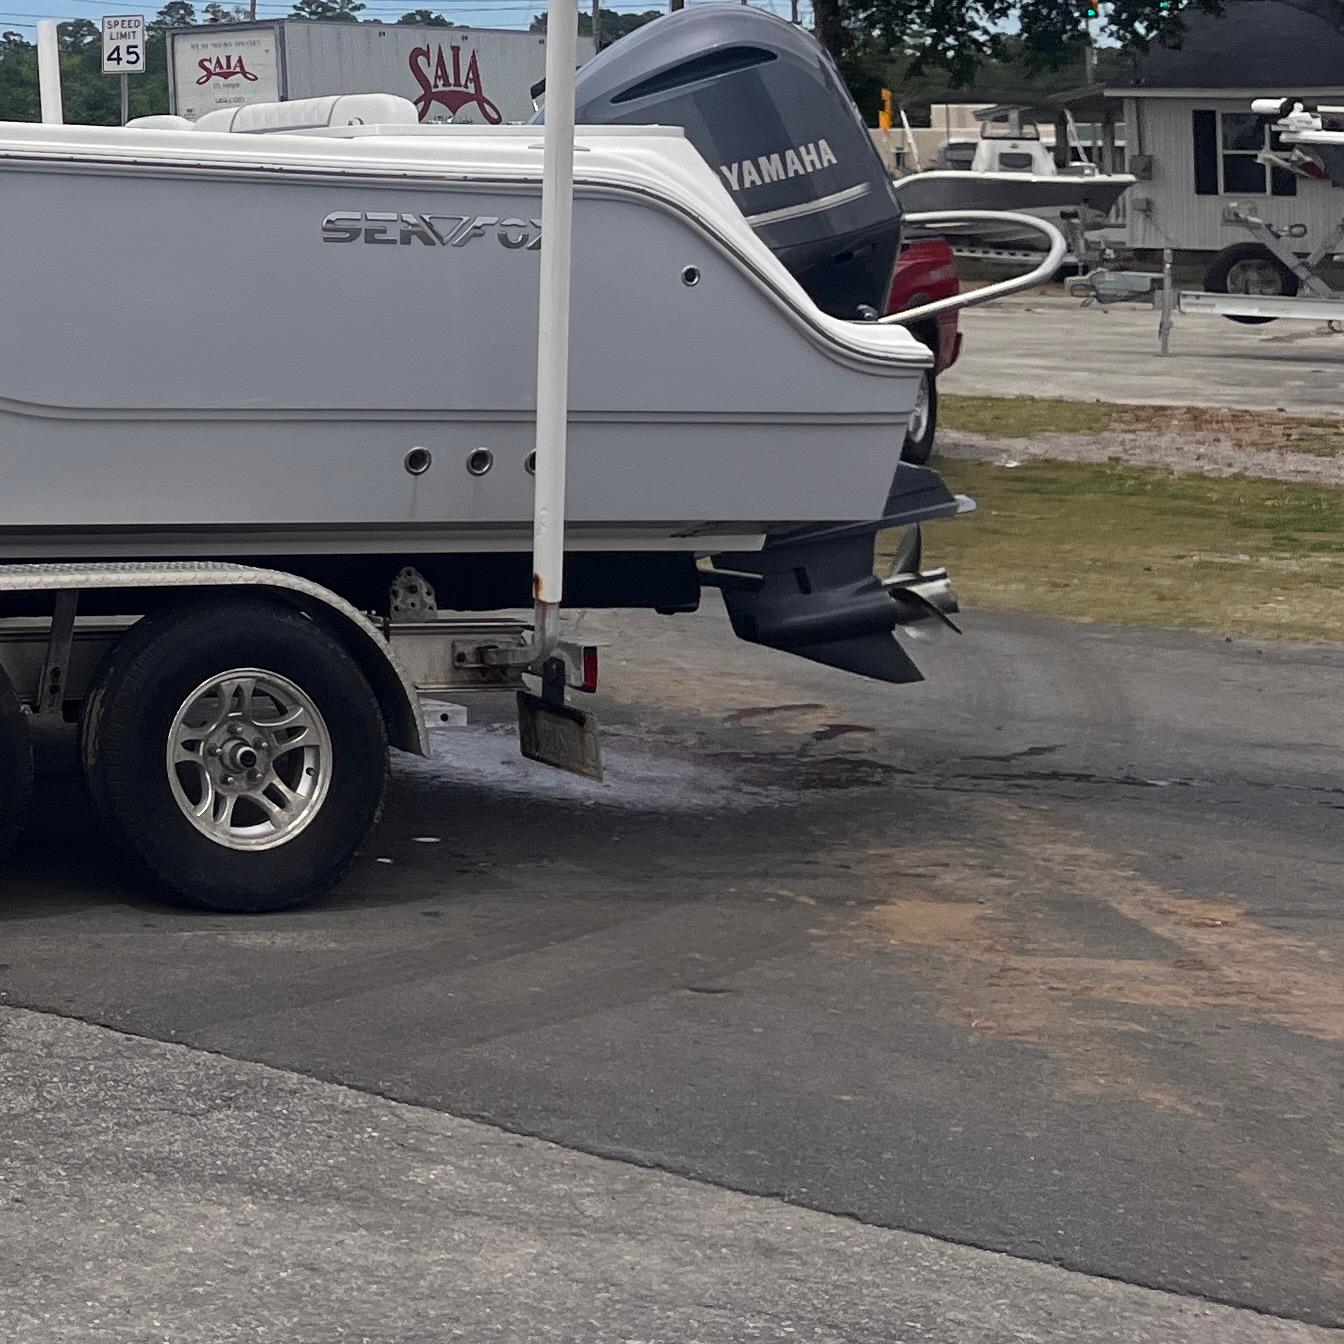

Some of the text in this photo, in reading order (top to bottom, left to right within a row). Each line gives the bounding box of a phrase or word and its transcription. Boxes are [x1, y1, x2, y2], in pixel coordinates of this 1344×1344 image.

[106, 19, 140, 29] SPEED
[109, 31, 137, 41] LIMIT
[106, 44, 140, 66] 45
[196, 55, 258, 85] SAIA
[409, 44, 502, 124] SAIA
[719, 139, 837, 191] YAMAHA
